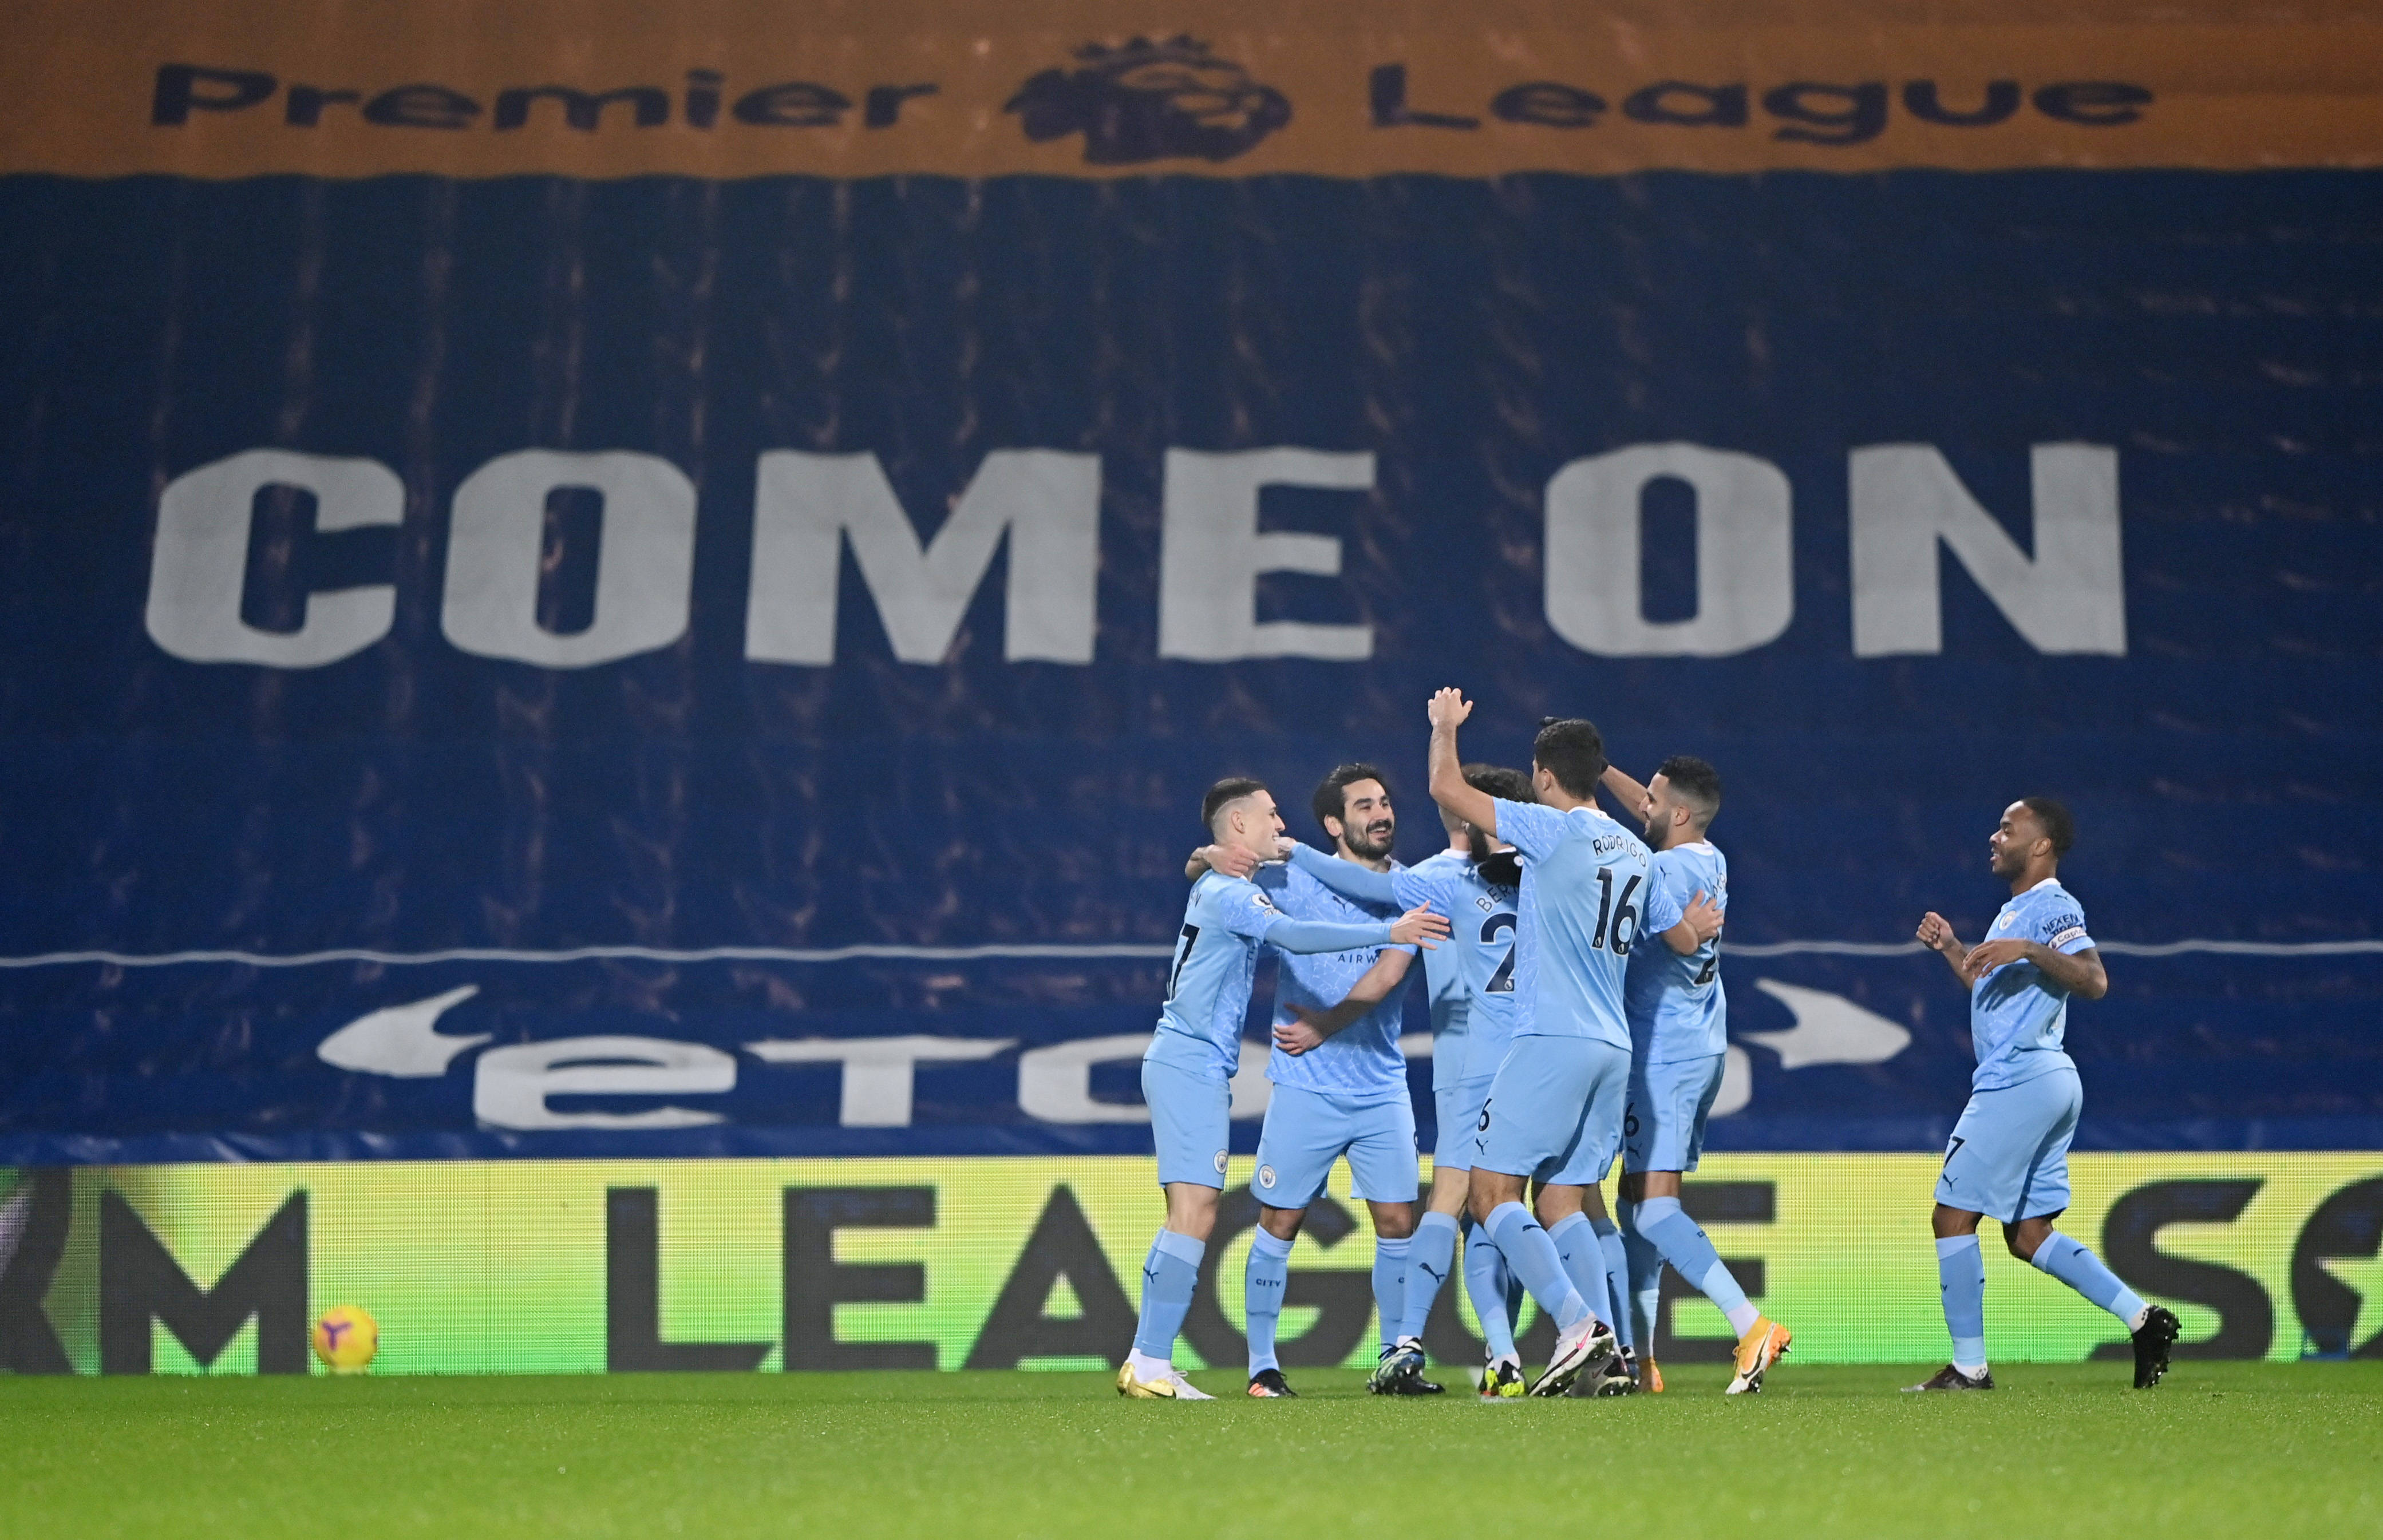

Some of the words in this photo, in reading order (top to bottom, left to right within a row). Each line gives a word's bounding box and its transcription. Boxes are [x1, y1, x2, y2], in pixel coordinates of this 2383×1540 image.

[150, 62, 940, 132] Premier
[1368, 62, 2157, 147] League
[144, 448, 1377, 670] COME
[1543, 441, 2128, 658] ON
[1592, 834, 1647, 868] RODRIGO
[1475, 884, 1518, 913] BER
[1591, 866, 1642, 955] 16
[2042, 913, 2079, 935] NEXEN
[1943, 1135, 1966, 1169] 7
[1255, 1277, 1282, 1288] CITY
